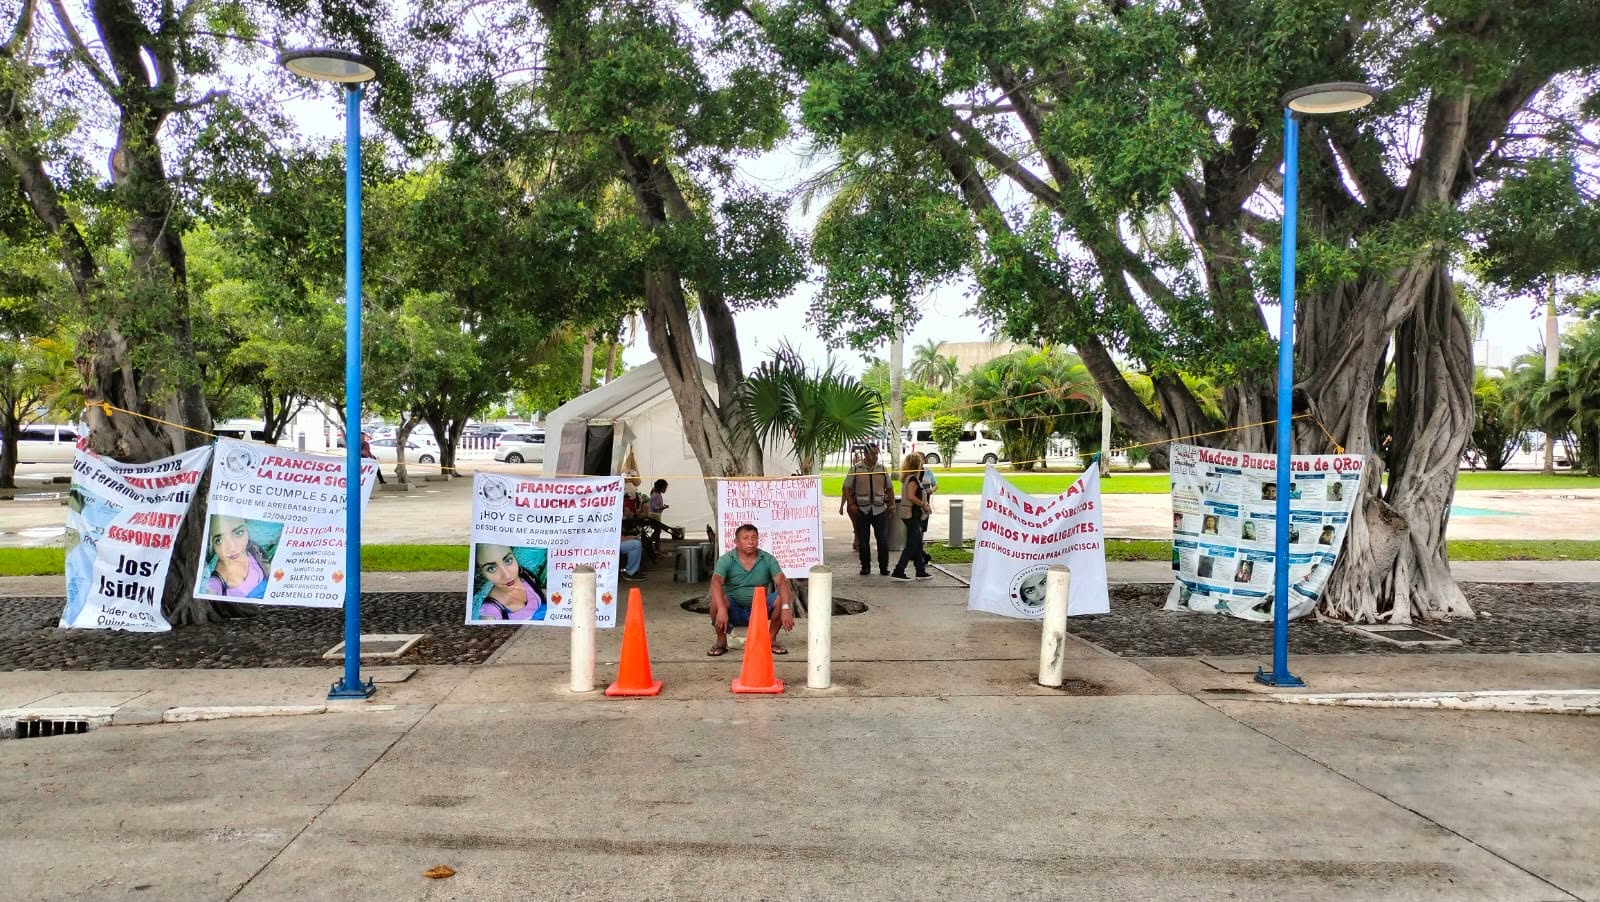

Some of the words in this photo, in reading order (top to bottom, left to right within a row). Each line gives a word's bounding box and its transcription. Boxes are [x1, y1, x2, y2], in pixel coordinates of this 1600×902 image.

[74, 456, 93, 476] uis
[1200, 448, 1238, 468] Madres
[1241, 454, 1310, 471] Buscaras
[1314, 460, 1329, 471] de
[256, 468, 273, 480] LA
[276, 471, 321, 485] LUCHA
[249, 485, 263, 495] SE
[265, 487, 317, 501] CUMPLE
[320, 494, 327, 502] 5
[329, 493, 347, 504] AÑ
[515, 483, 592, 495] ¡FRANCISCA
[212, 494, 234, 503] DESDE
[236, 498, 252, 506] QUE
[255, 500, 266, 508] ME
[267, 501, 327, 514] ARREBATASTES
[515, 497, 530, 508] LA
[534, 498, 577, 509] LUCHA
[263, 511, 308, 523] 22/06/2020
[480, 510, 506, 521] ¡HOY
[509, 513, 523, 522] SE
[526, 514, 575, 524] CUMPLE
[577, 514, 584, 523] 5
[1055, 501, 1094, 520] PÚBLICOS
[475, 524, 498, 532] DESDE
[981, 520, 1019, 541] OMISOS
[1021, 533, 1029, 543] Y
[1031, 522, 1099, 545] NEGLIGENTES.
[1011, 551, 1045, 561] JUSTICIA
[1045, 551, 1061, 559] PARA
[555, 561, 611, 570] FRANSCA!
[270, 591, 313, 599] QUEMENLO
